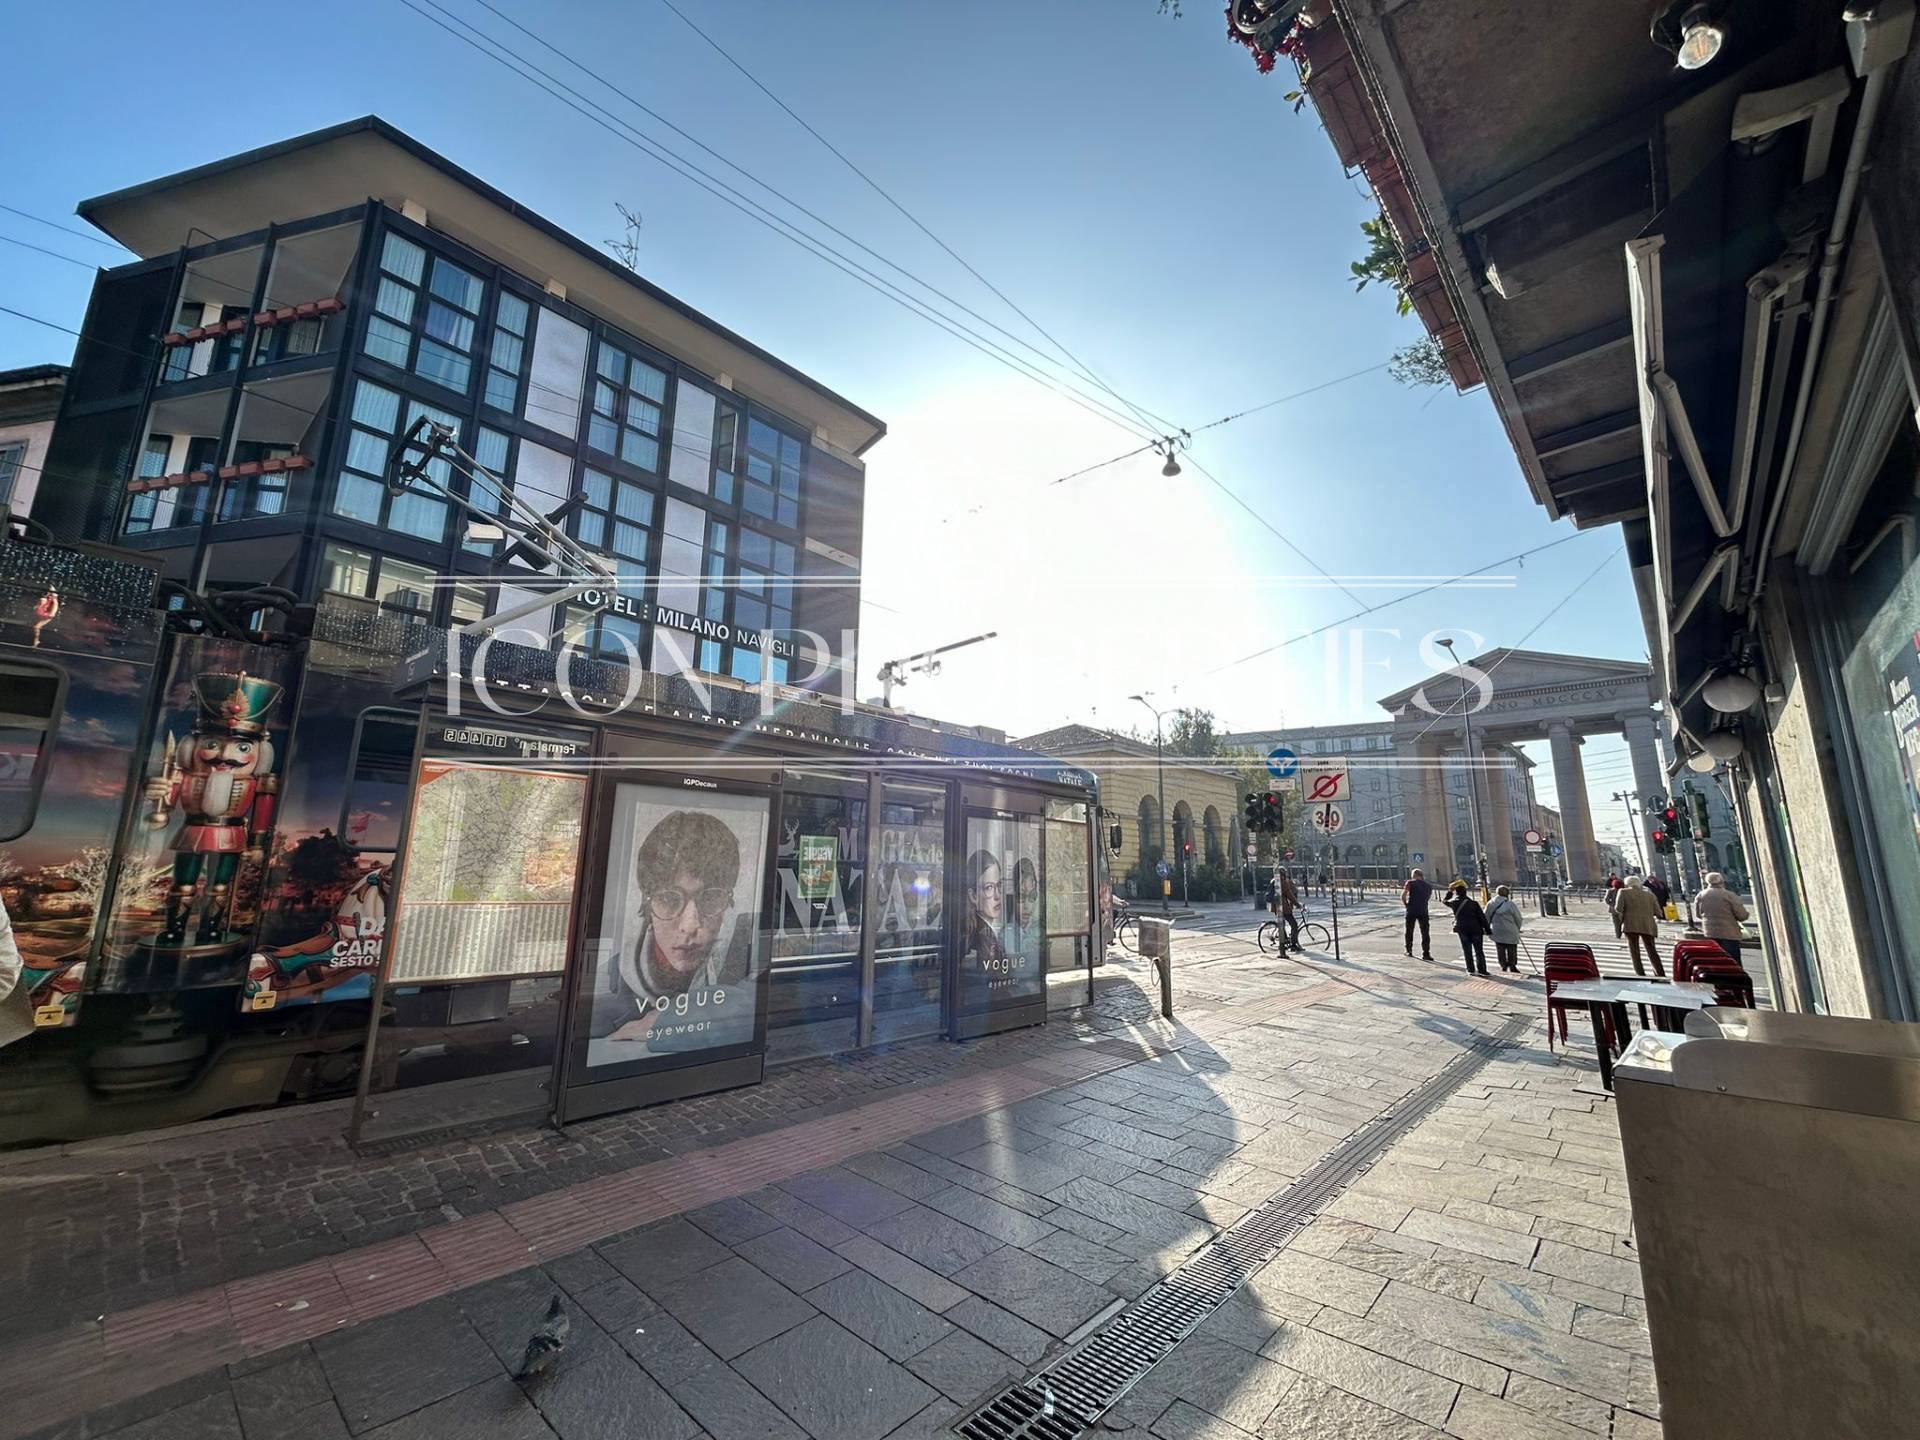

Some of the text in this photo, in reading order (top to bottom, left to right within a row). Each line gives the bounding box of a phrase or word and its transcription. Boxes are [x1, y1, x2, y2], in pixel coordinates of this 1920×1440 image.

[656, 607, 730, 640] MILANO
[737, 629, 795, 657] NAVIGLI
[838, 827, 924, 865] MGIA
[329, 954, 374, 968] SESTO
[983, 956, 1026, 974] vogue
[636, 989, 726, 1016] vogue
[646, 1020, 712, 1041] eyewear
